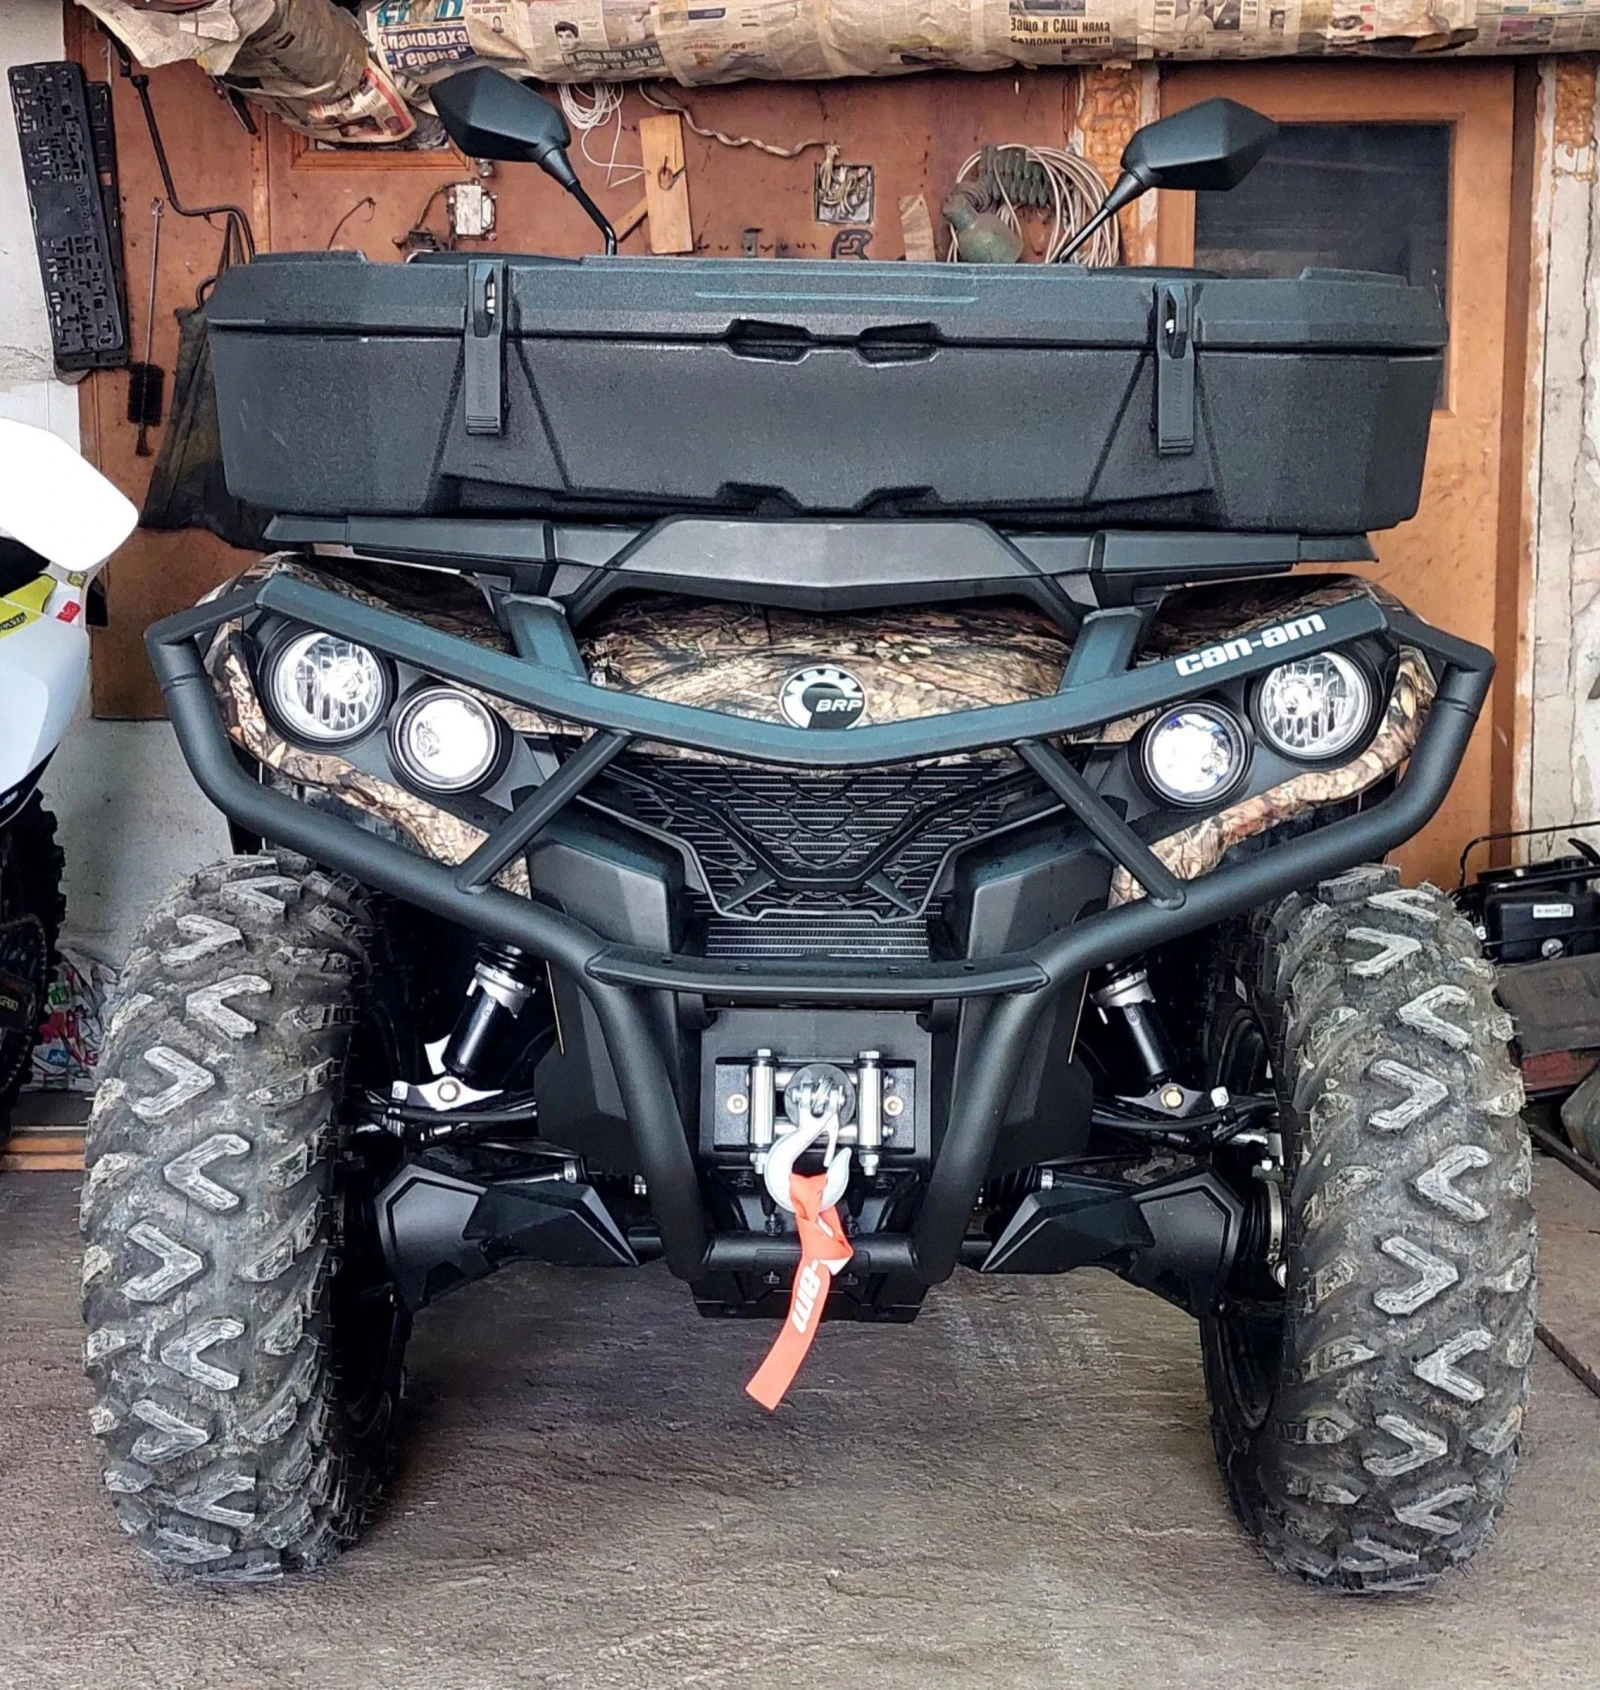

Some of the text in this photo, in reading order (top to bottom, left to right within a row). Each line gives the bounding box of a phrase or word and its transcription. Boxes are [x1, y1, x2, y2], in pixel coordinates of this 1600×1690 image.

[1010, 17, 1110, 34] Защо в САЩ няма
[378, 30, 469, 50] Опаковаха
[1071, 35, 1110, 45] кучета
[1175, 614, 1326, 677] can-am
[815, 699, 864, 713] BRP
